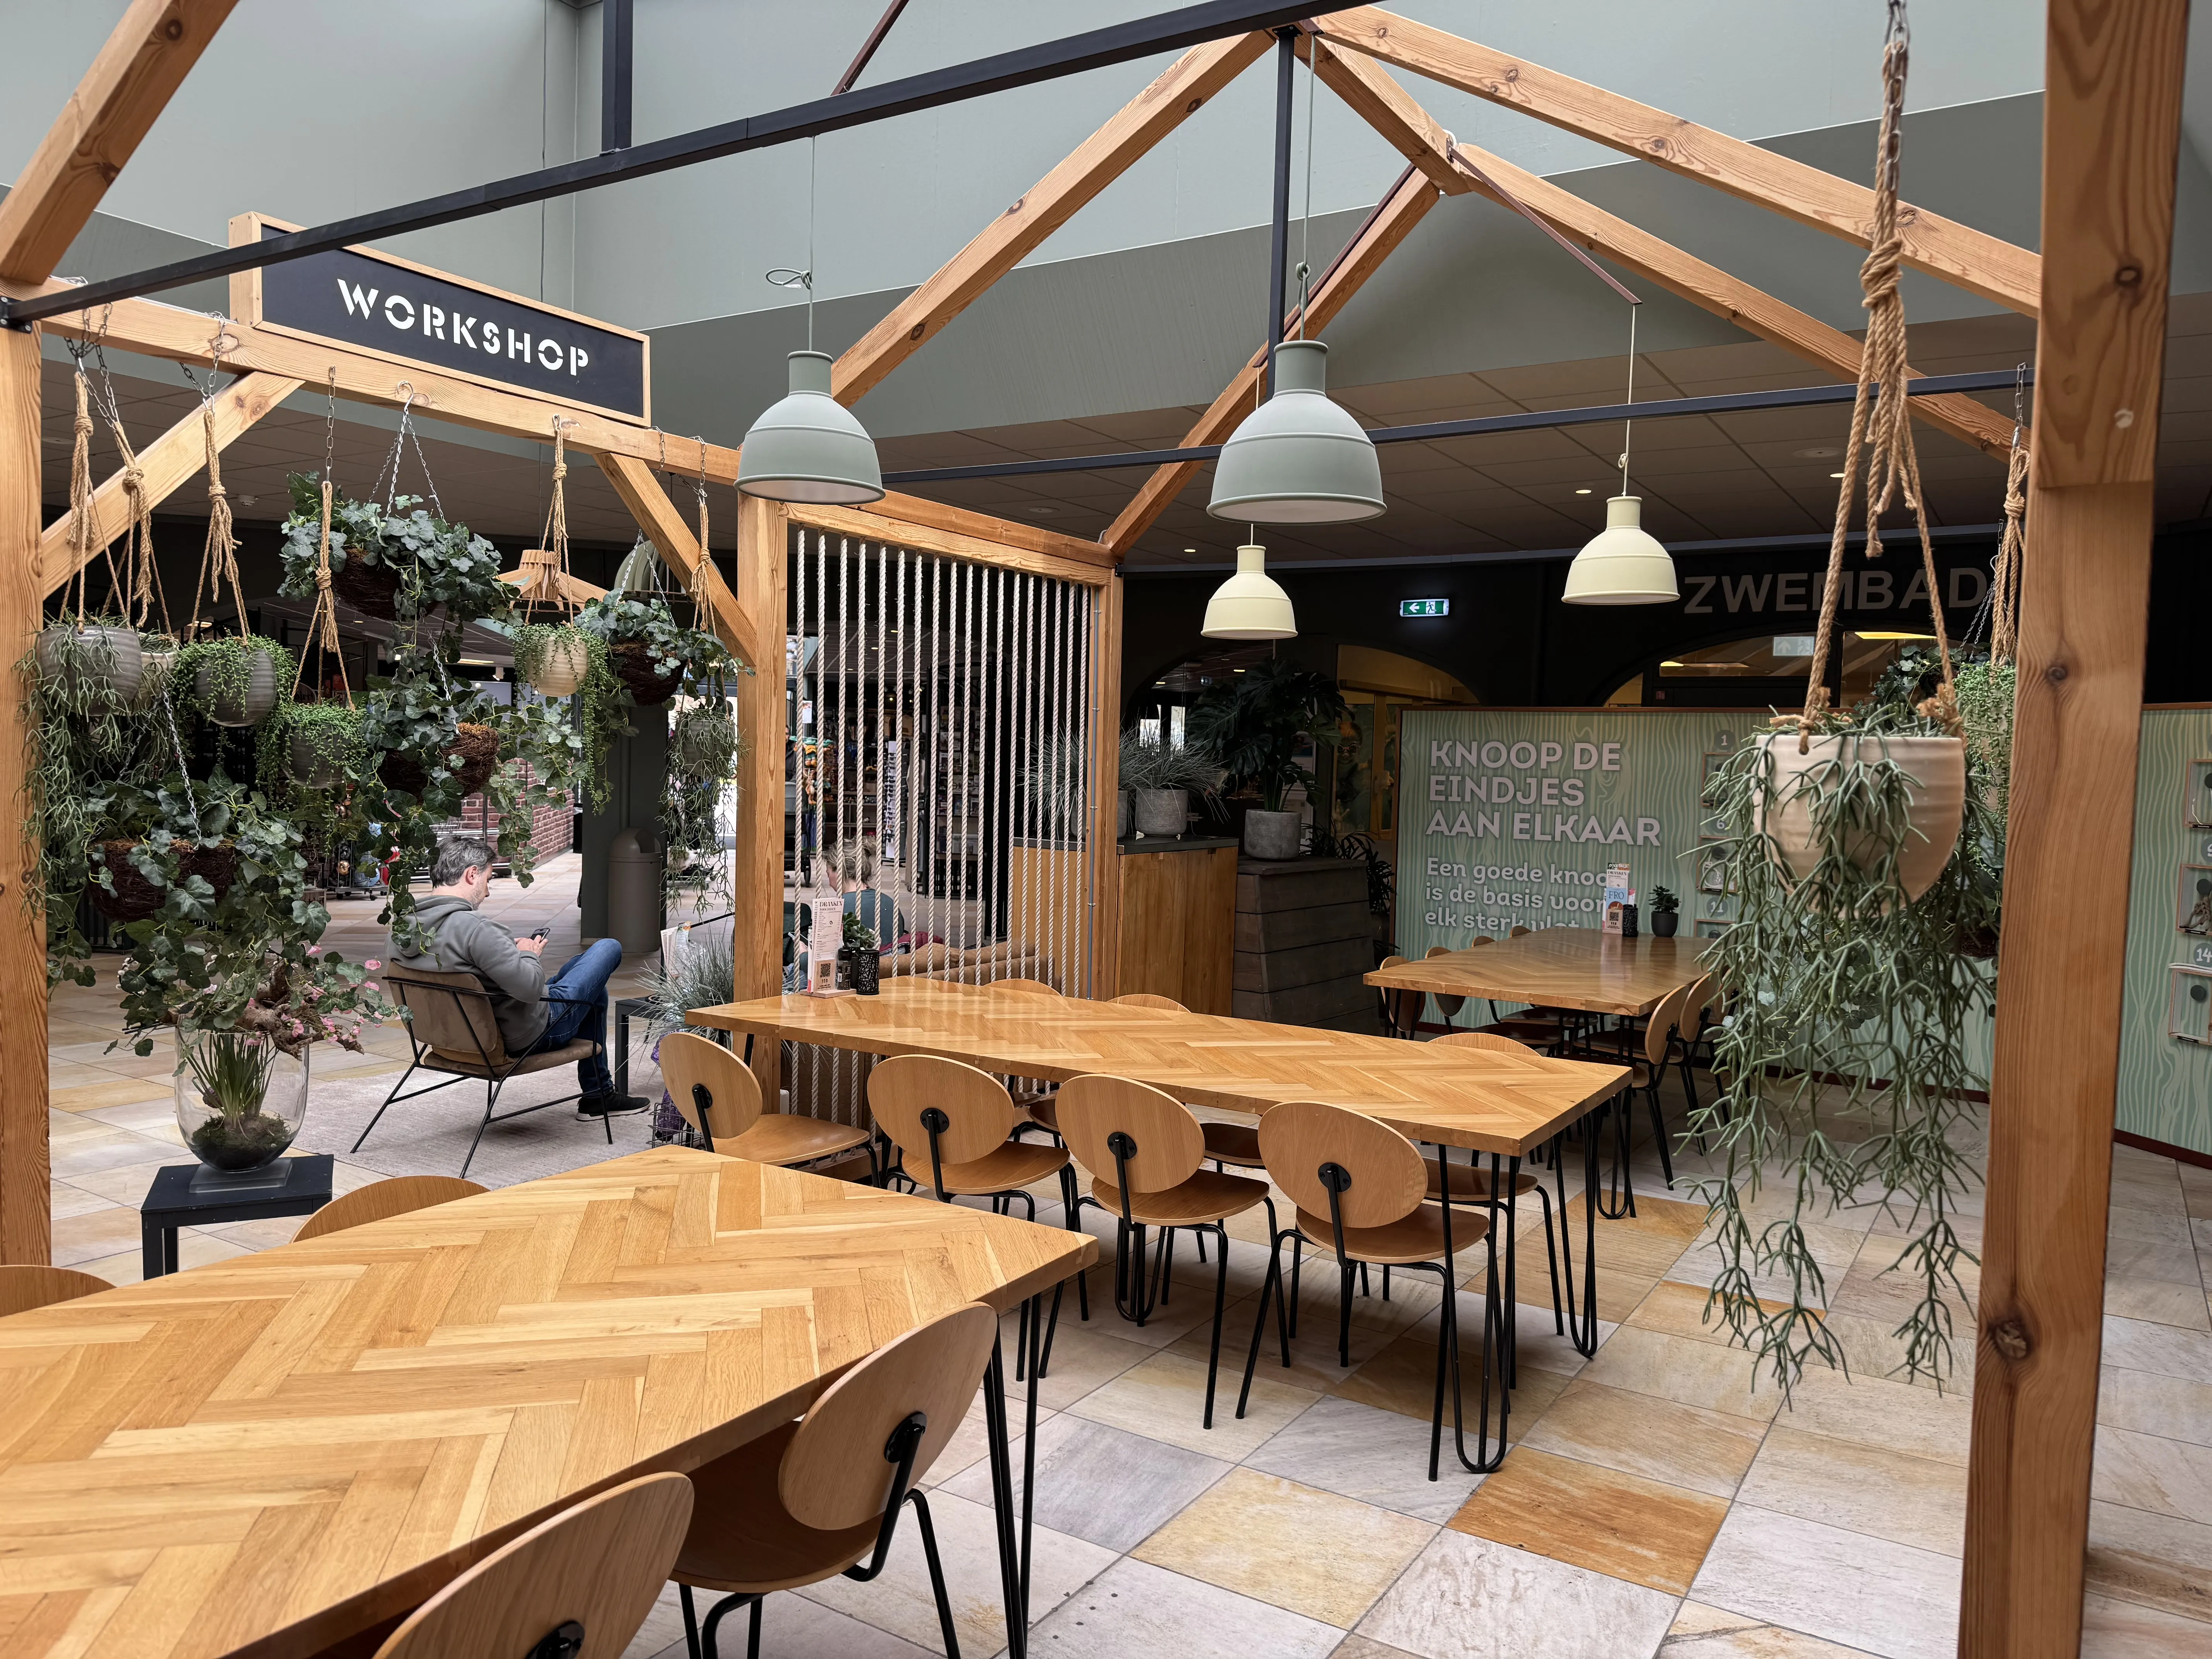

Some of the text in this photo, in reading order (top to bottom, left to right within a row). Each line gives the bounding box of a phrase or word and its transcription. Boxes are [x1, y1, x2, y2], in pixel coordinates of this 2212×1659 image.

[337, 278, 589, 376] WORKSHOP
[1684, 567, 1987, 613] ZWEMBAD
[1721, 735, 1728, 746] 1
[1431, 740, 1620, 771] KNOOP DE
[1429, 775, 1584, 806] EINDJES
[1425, 809, 1661, 846] AAN ELKAAR
[1717, 818, 1725, 829] 6
[1427, 857, 1466, 877] Een
[1473, 862, 1542, 884] goede
[1550, 864, 1607, 886] knoo
[1426, 882, 1604, 912] is de basis voor
[1609, 891, 1624, 900] FRO
[1711, 902, 1723, 912] 11
[1425, 907, 1457, 927] elk
[1464, 913, 1524, 931] sterk
[2197, 948, 2212, 963] 14
